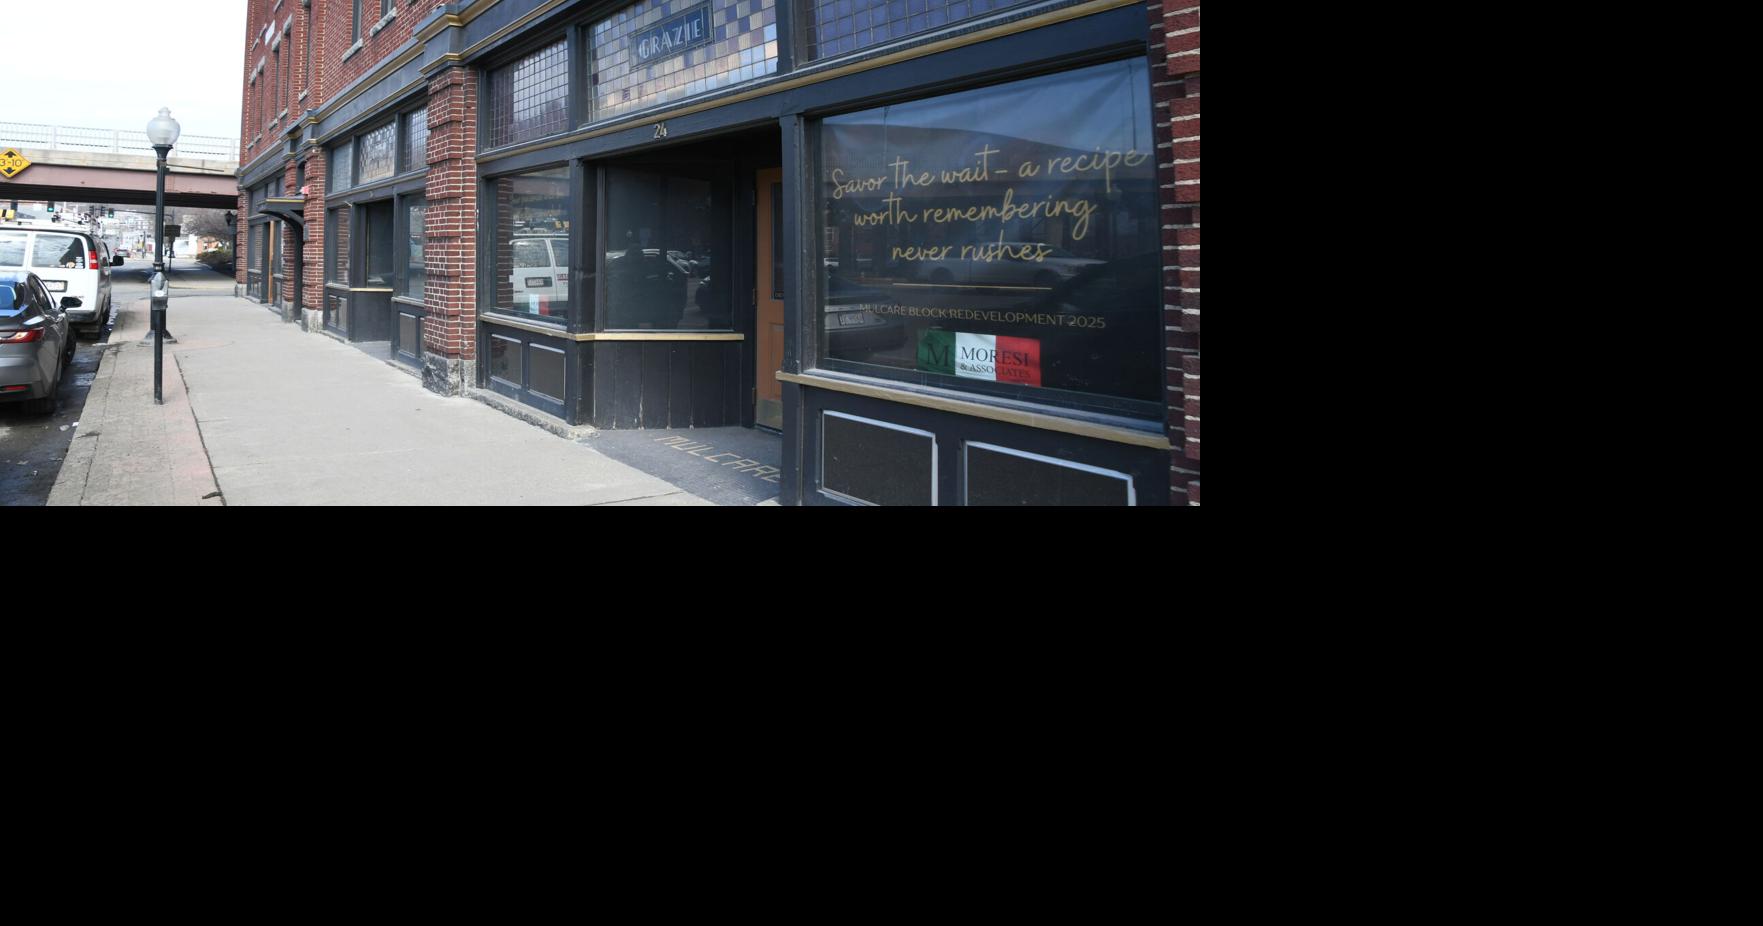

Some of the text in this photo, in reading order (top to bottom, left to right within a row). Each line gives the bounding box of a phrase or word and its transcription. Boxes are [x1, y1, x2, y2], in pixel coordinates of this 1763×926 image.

[638, 18, 702, 59] GRAZIE
[653, 122, 667, 139] 24
[832, 168, 887, 199] Savor
[888, 155, 935, 189] the
[1018, 161, 1041, 178] a
[1047, 146, 1148, 193] recipe
[854, 188, 1098, 241] worth remembering
[892, 229, 1053, 264] never rushes
[860, 303, 1107, 330] MULCARE BLOCK REDEVELOPMENT 2025
[926, 343, 950, 367] M
[960, 346, 1030, 367] MORESI
[960, 362, 1032, 379] & ASSOCIATES
